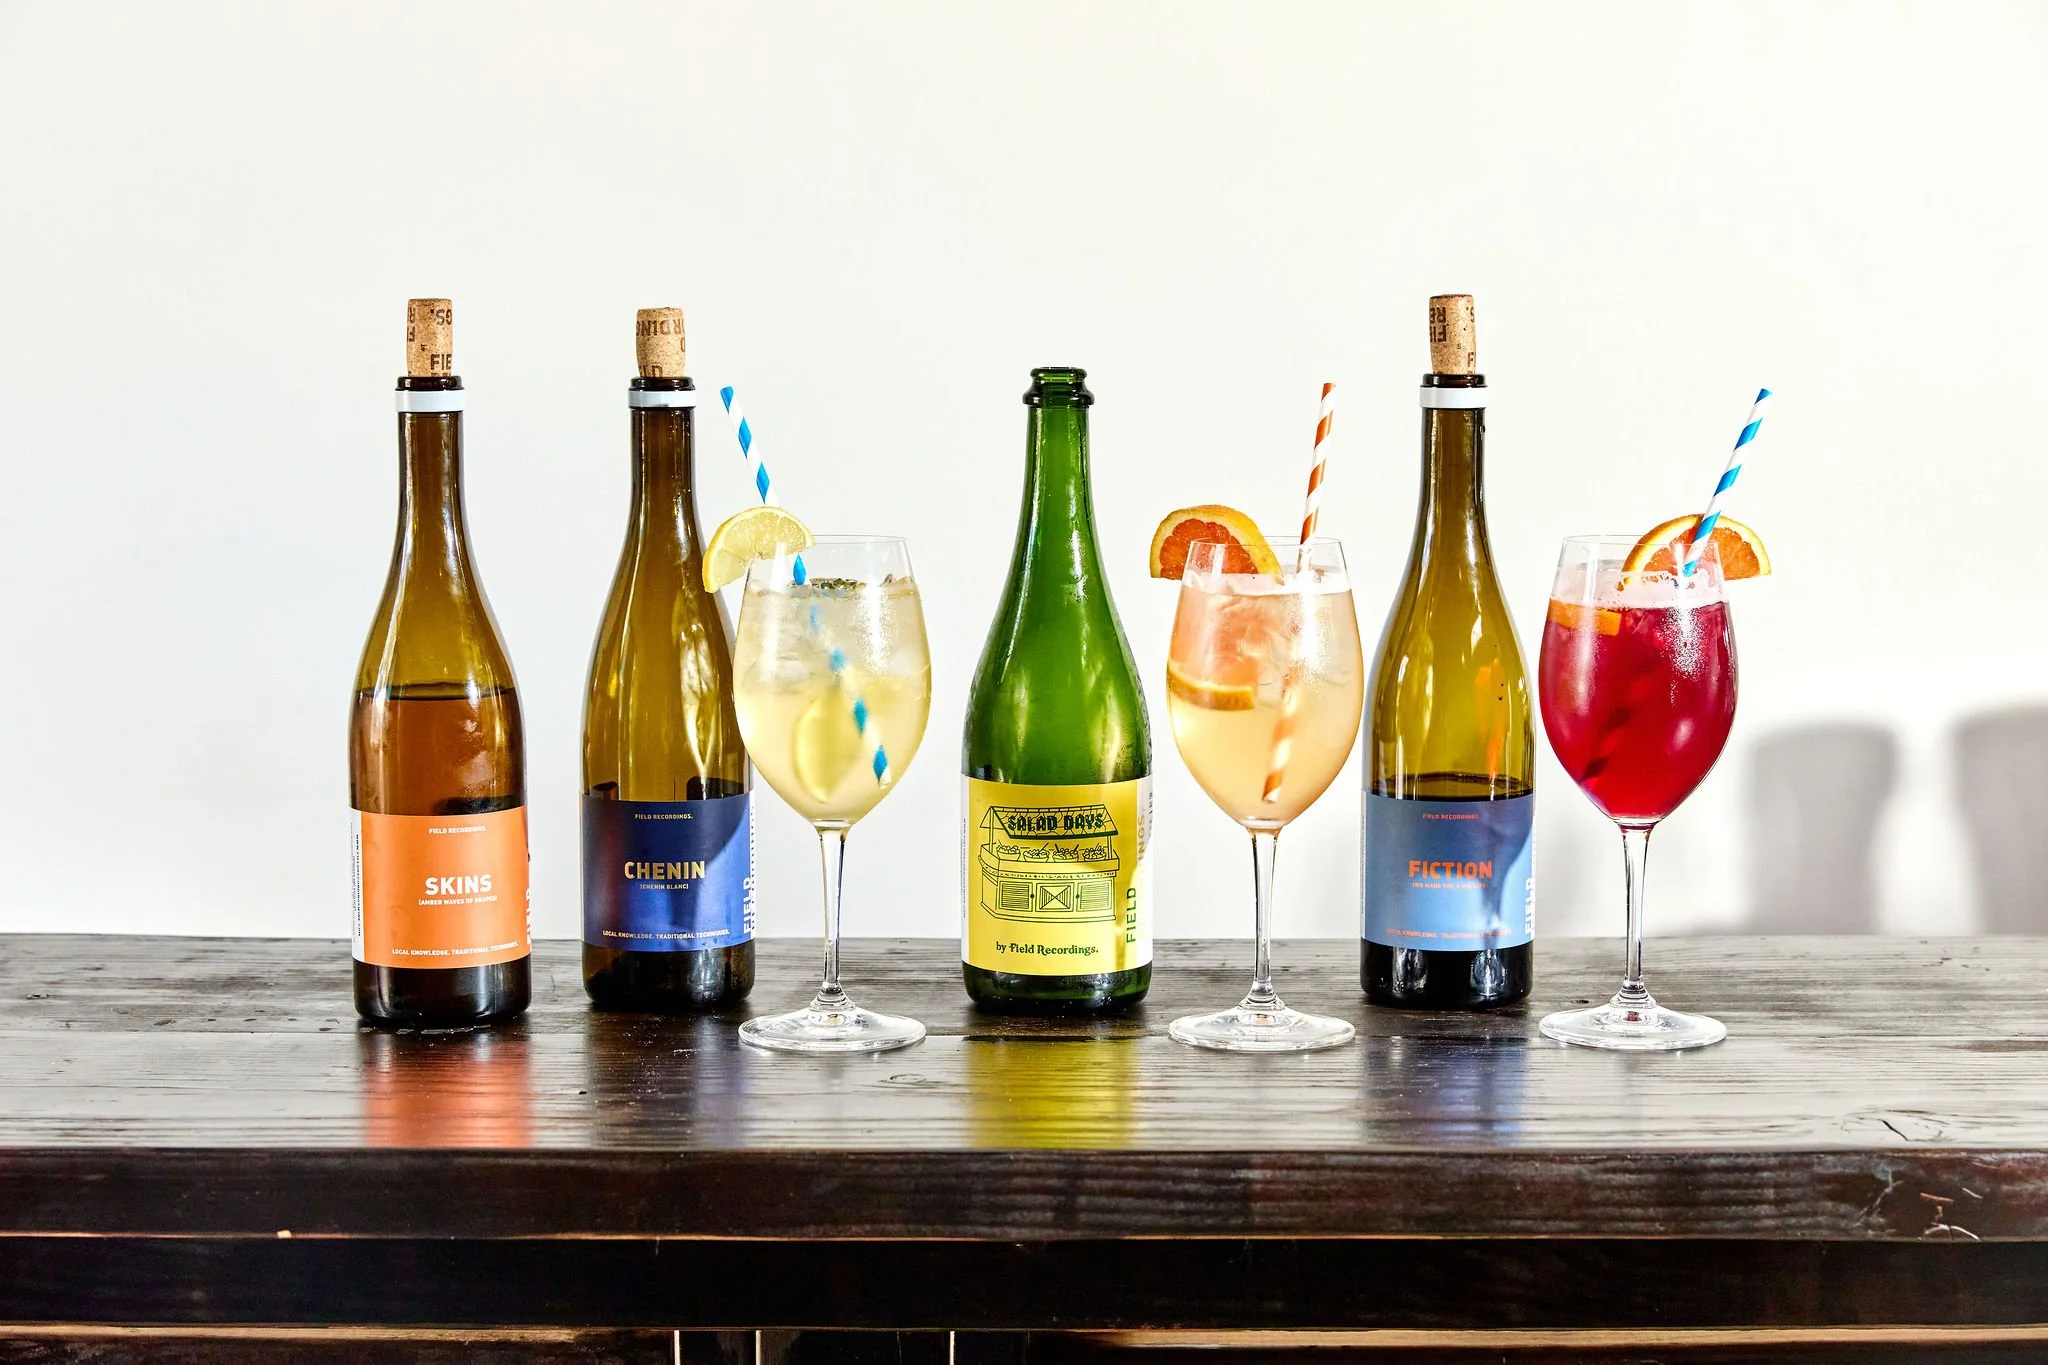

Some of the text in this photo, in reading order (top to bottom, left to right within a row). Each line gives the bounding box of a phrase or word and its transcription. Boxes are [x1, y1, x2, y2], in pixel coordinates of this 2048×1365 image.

[1006, 812, 1104, 833] SALAD DAYS
[428, 827, 447, 835] FIELD
[624, 860, 705, 880] CHENIN
[1408, 860, 1493, 879] FICTION
[425, 874, 492, 896] SKINS
[443, 897, 464, 905] WAVES
[465, 896, 473, 904] OF
[1126, 887, 1137, 944] FIELD
[602, 930, 617, 938] LOCAL
[656, 931, 695, 940] TRADITIONAL
[391, 948, 410, 956] LOCAL
[995, 942, 1099, 956] by Field Recordings.
